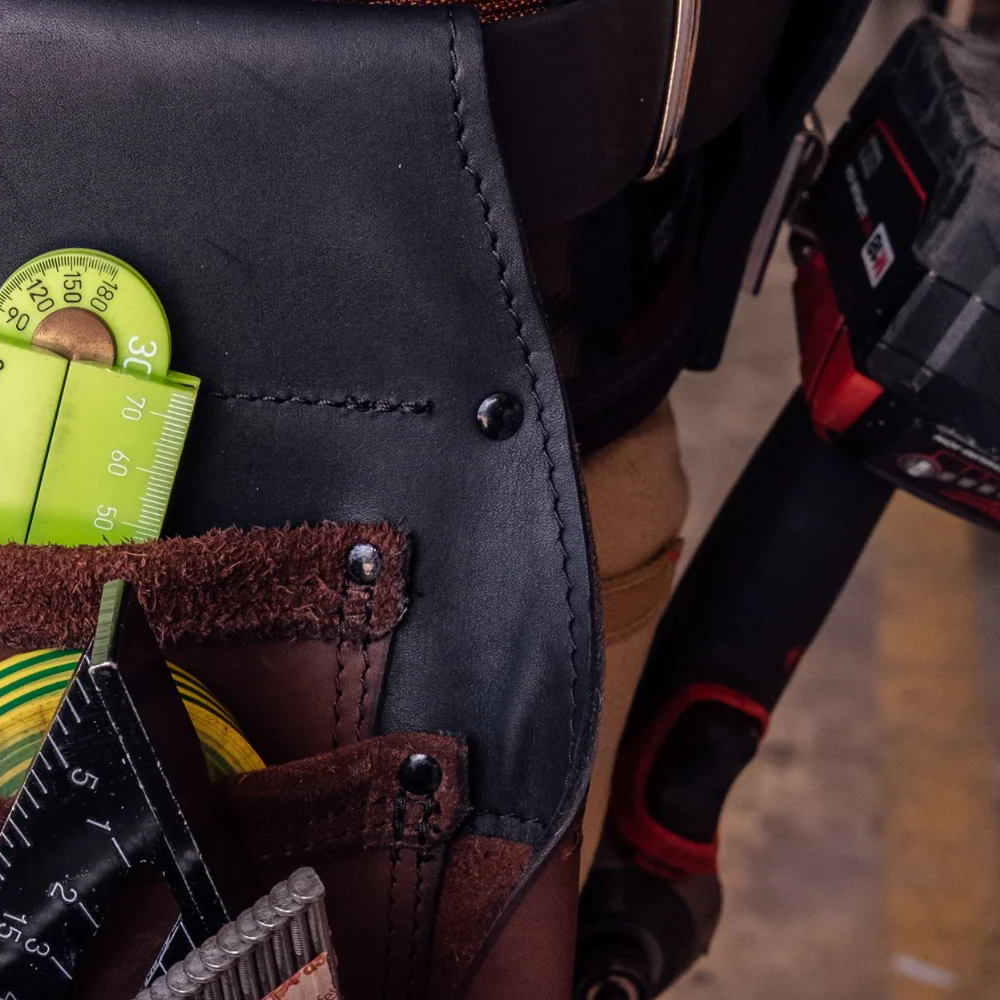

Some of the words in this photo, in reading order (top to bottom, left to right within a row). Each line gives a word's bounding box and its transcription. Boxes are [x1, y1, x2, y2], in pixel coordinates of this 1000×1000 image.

[25, 278, 54, 313] 120
[63, 271, 83, 304] 150
[90, 280, 118, 312] 180
[5, 306, 31, 331] 90
[121, 395, 146, 421] 70
[107, 449, 130, 477] 60
[93, 504, 117, 531] 50
[71, 768, 99, 790] 5
[49, 881, 78, 904] 2
[25, 937, 50, 957] 3
